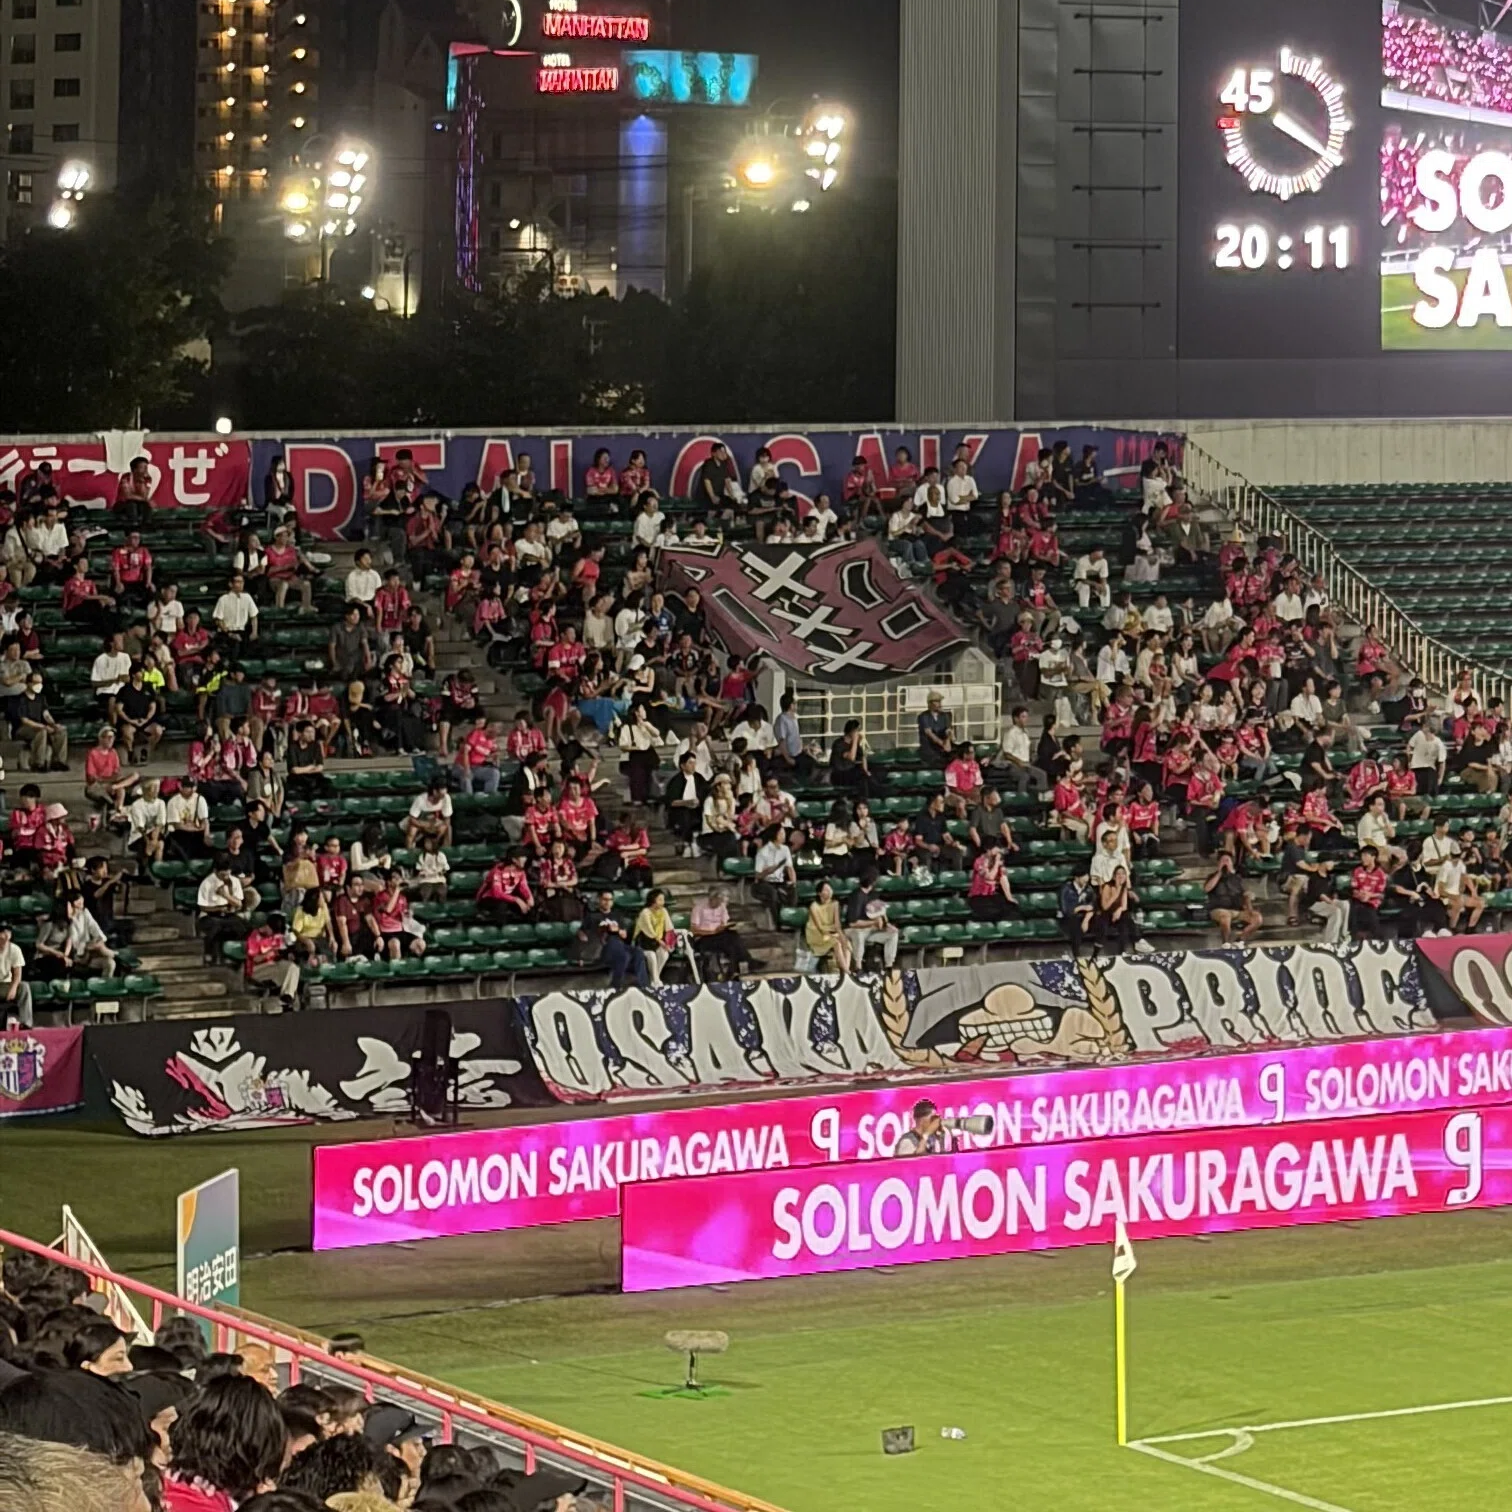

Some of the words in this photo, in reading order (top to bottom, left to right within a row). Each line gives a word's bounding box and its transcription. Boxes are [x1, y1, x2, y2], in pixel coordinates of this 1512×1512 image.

[543, 13, 649, 40] MANHATTAN
[539, 68, 618, 92] MANHATTAN
[1220, 68, 1274, 113] 45
[1215, 223, 1349, 270] 20:11
[532, 971, 906, 1093] OSAKA
[1104, 939, 1421, 1052] PRIDE
[353, 1151, 538, 1217] SOLOMON
[548, 1125, 789, 1194] SAKURAGAWA
[857, 1099, 1022, 1159] SOMON
[1031, 1078, 1246, 1140] SAKURAGAWA
[1259, 1062, 1287, 1126] 9
[1305, 1058, 1450, 1113] SOLOMON
[772, 1165, 1047, 1260] SOLOMON
[1063, 1133, 1419, 1232] SAKURAGAWA
[1443, 1112, 1484, 1207] 9
[187, 1246, 237, 1305] 明治安田
